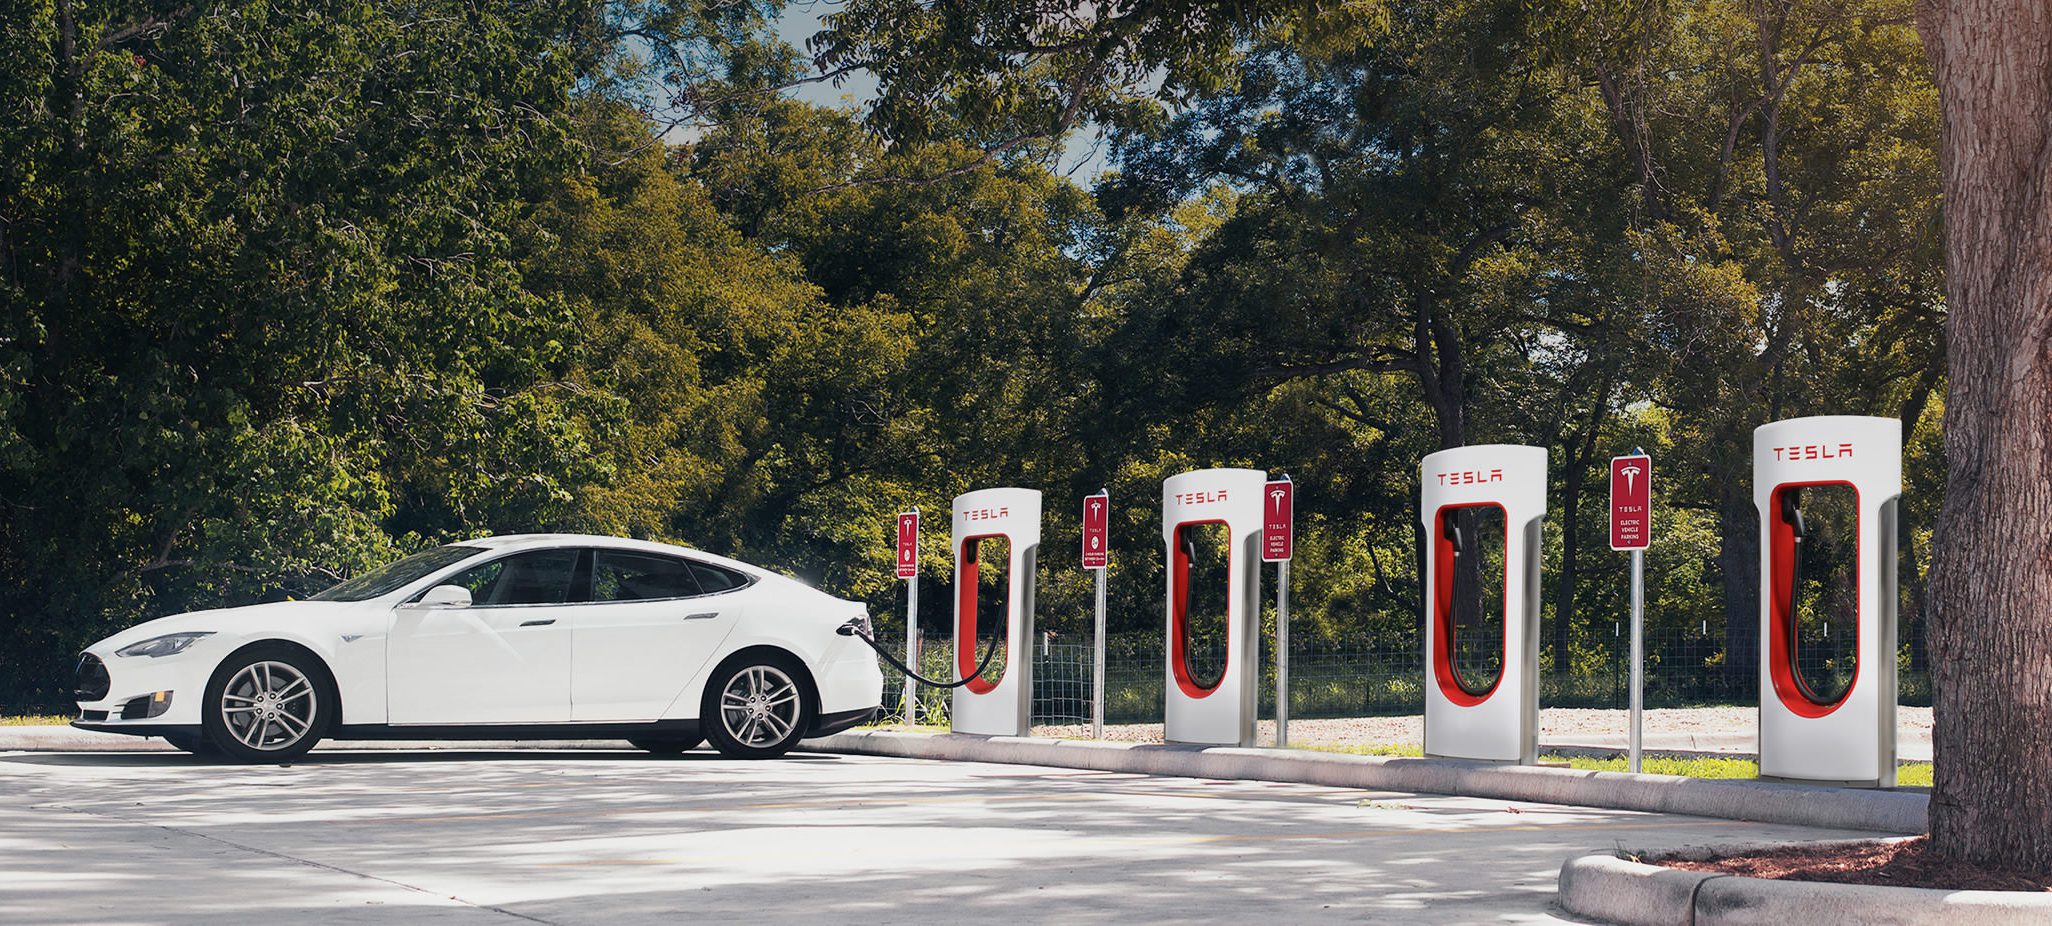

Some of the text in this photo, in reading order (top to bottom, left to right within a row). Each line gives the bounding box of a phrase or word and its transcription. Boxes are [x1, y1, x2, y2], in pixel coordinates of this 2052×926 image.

[1773, 443, 1852, 461] TESLA
[1437, 469, 1502, 486] TESLA
[1175, 490, 1227, 505] TESLA
[963, 507, 1008, 521] TESLA
